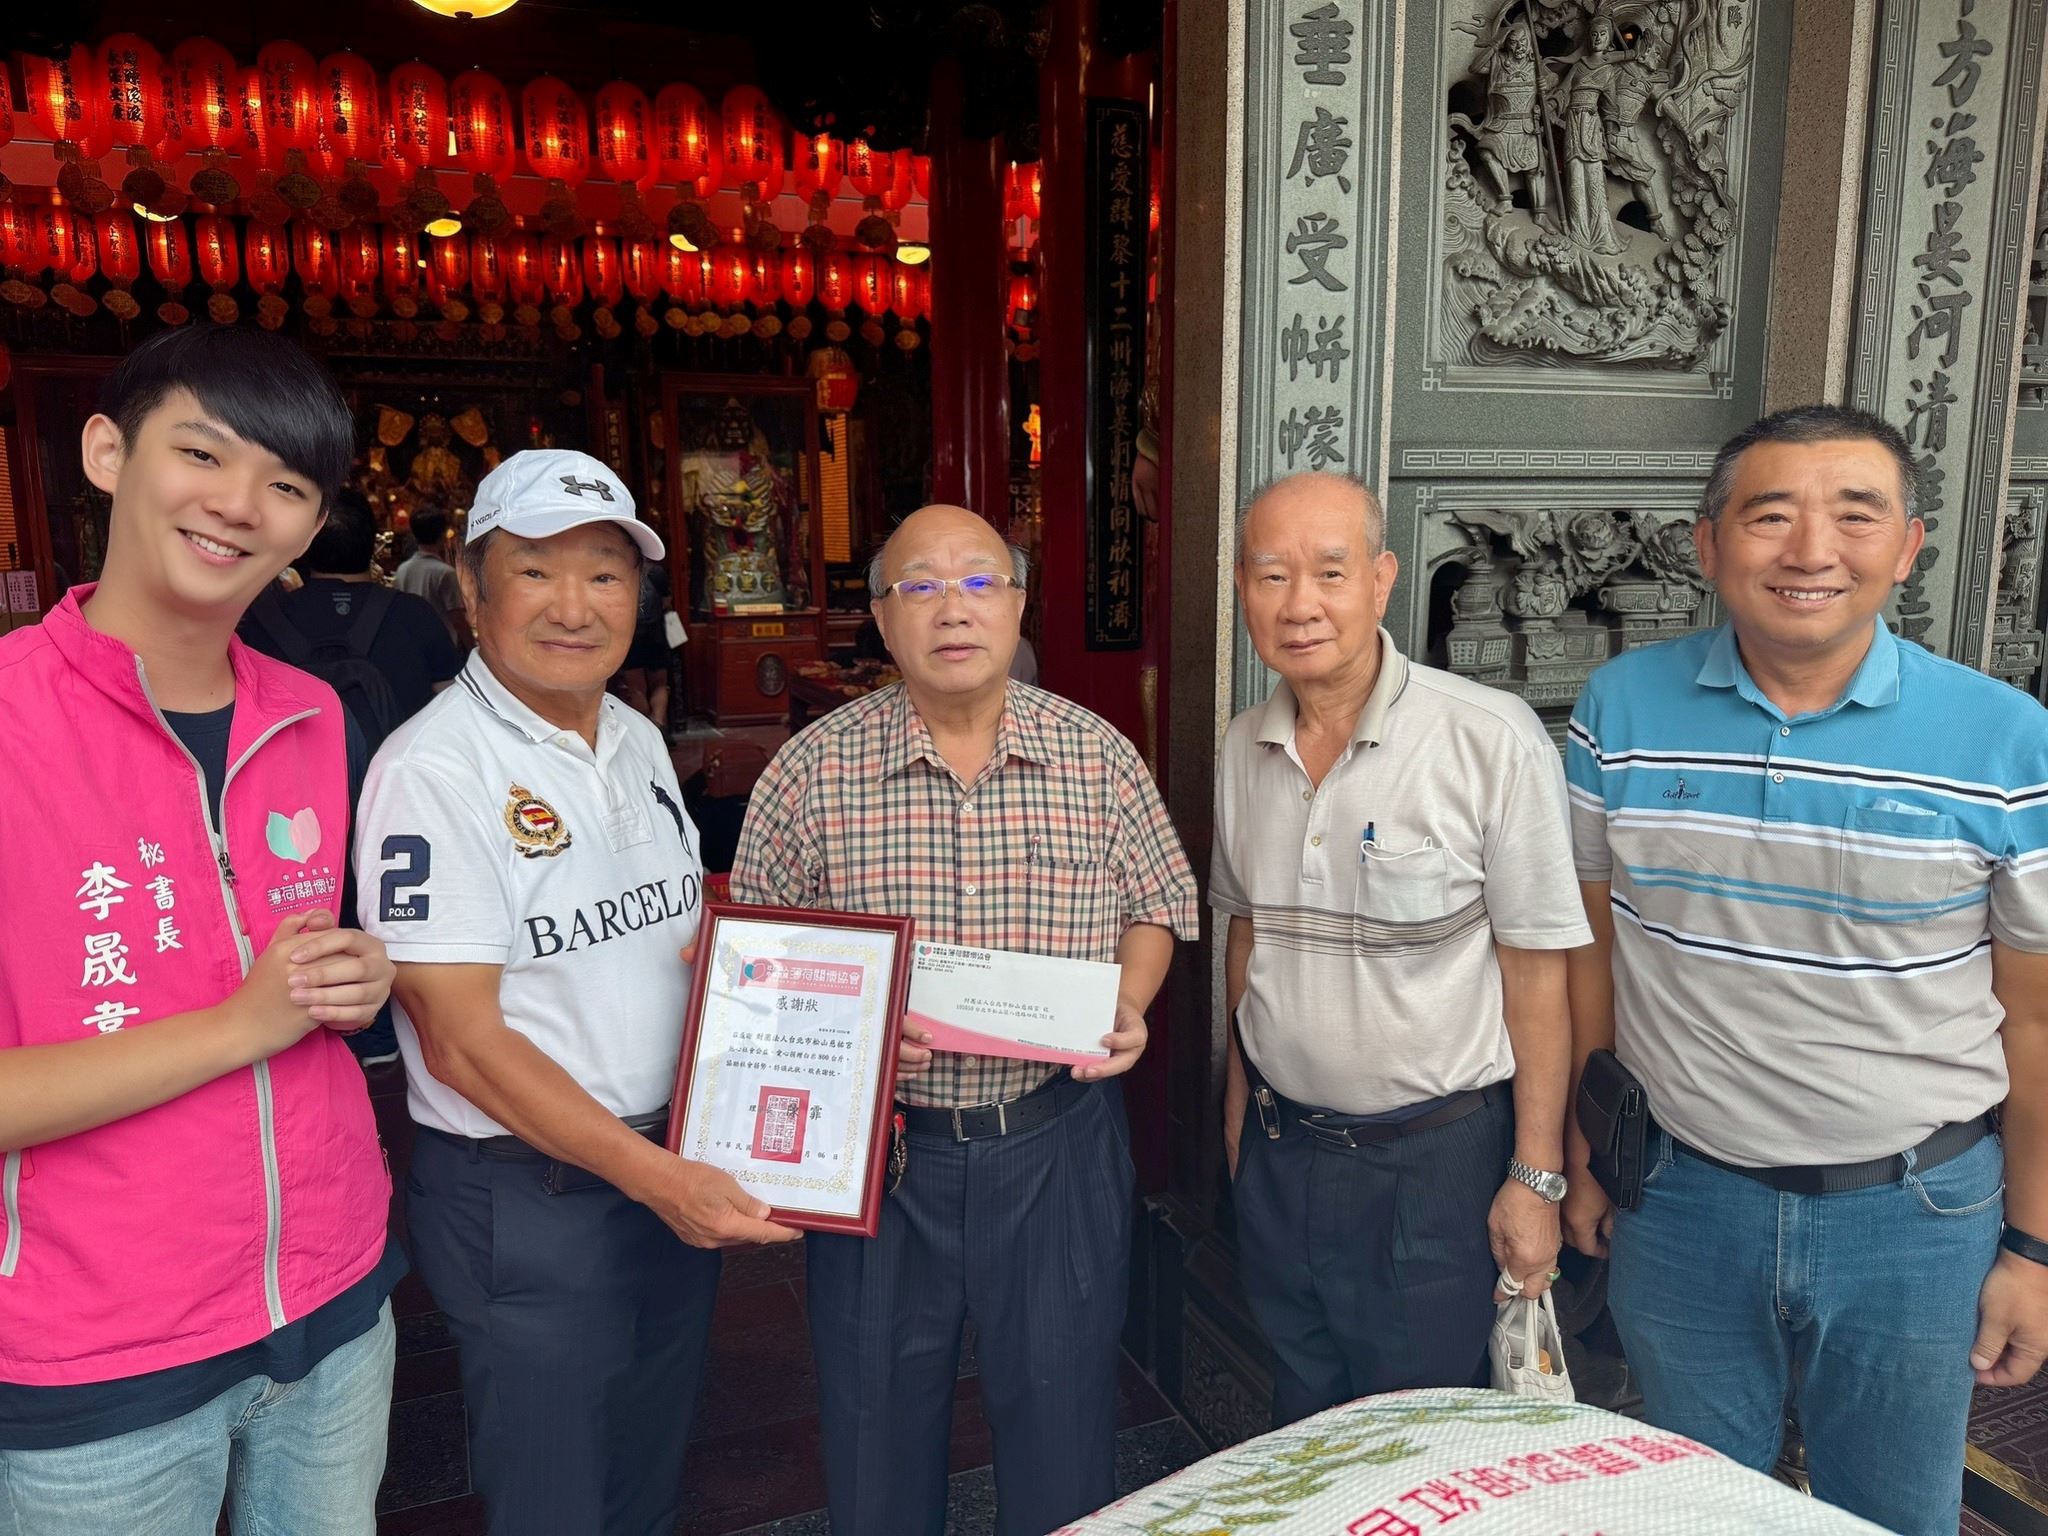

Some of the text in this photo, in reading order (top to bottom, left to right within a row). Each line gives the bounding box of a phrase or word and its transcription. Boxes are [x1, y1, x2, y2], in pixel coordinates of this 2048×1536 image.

[136, 836, 184, 954] 秘書長
[379, 834, 432, 922] 2
[388, 907, 416, 917] POLO
[776, 994, 819, 1014] 感謝狀
